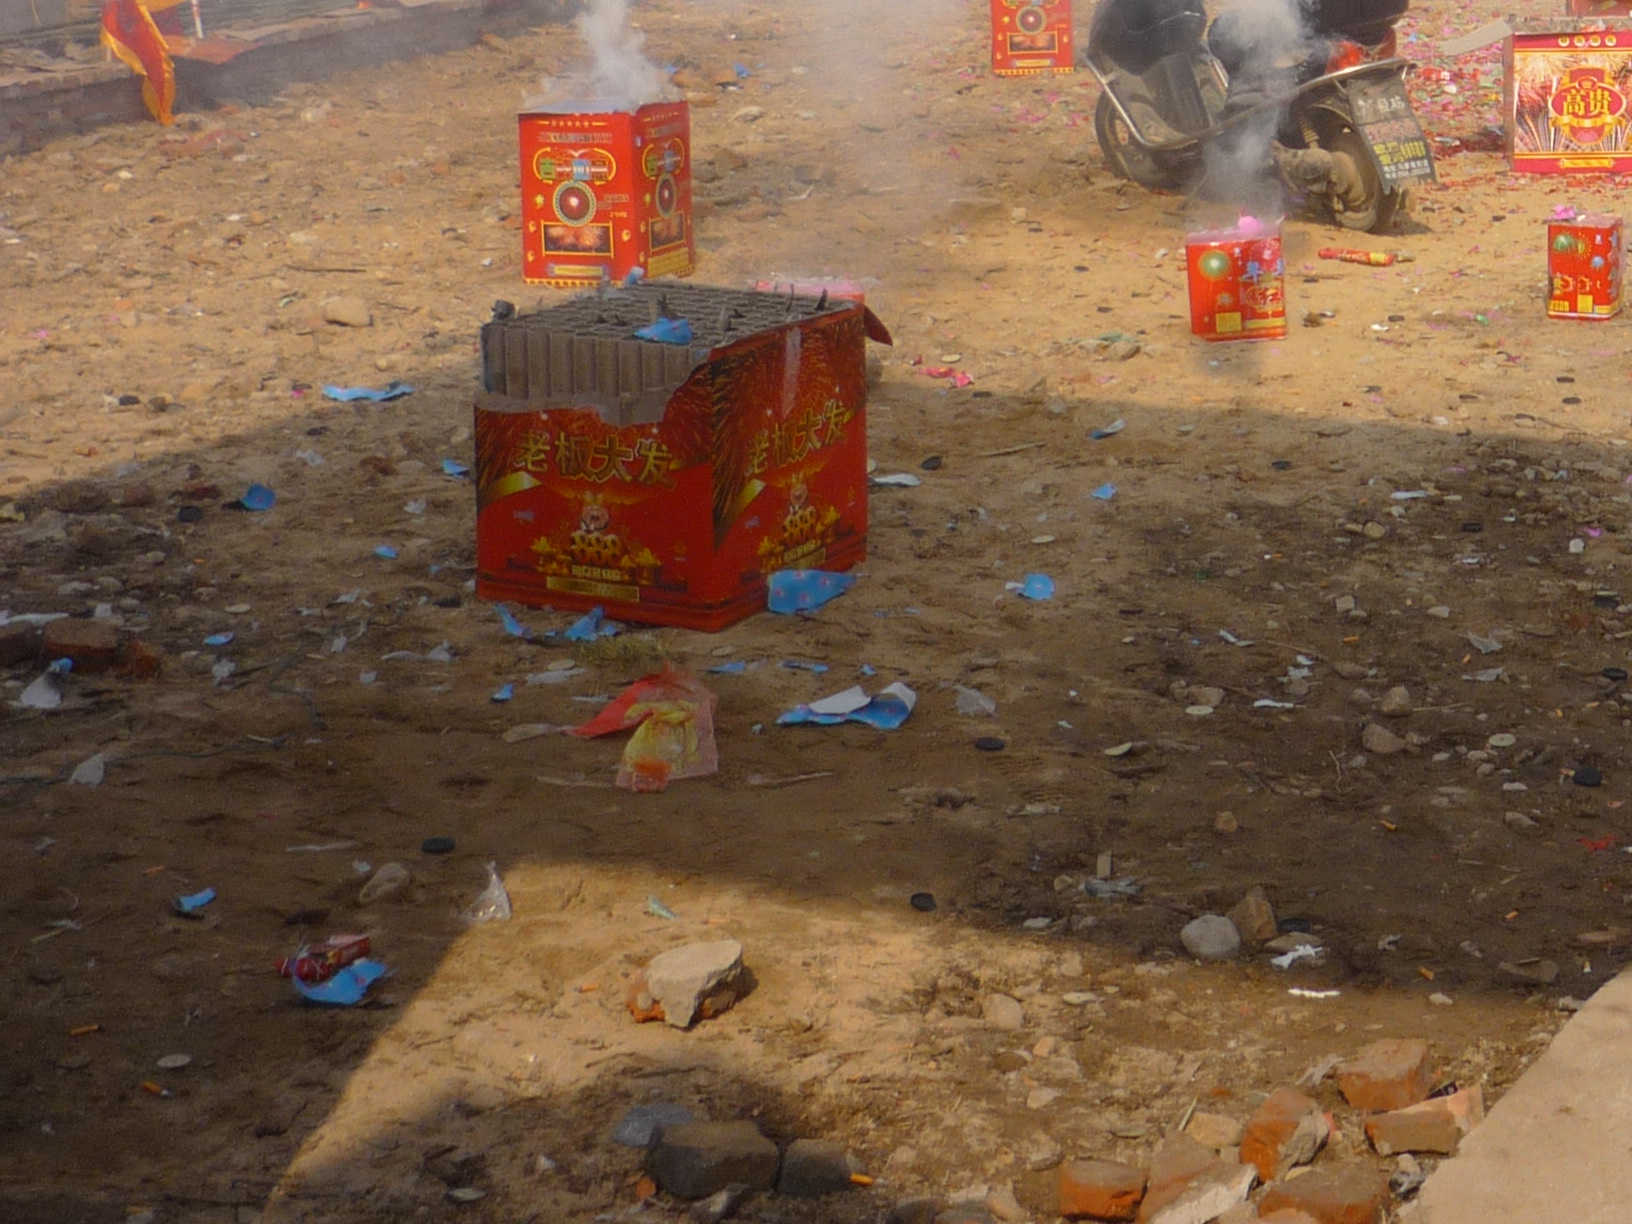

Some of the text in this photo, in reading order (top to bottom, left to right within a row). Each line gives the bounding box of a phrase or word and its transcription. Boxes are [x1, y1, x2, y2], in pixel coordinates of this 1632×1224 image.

[1562, 89, 1612, 117] 高贵
[515, 431, 677, 492] 老板大发
